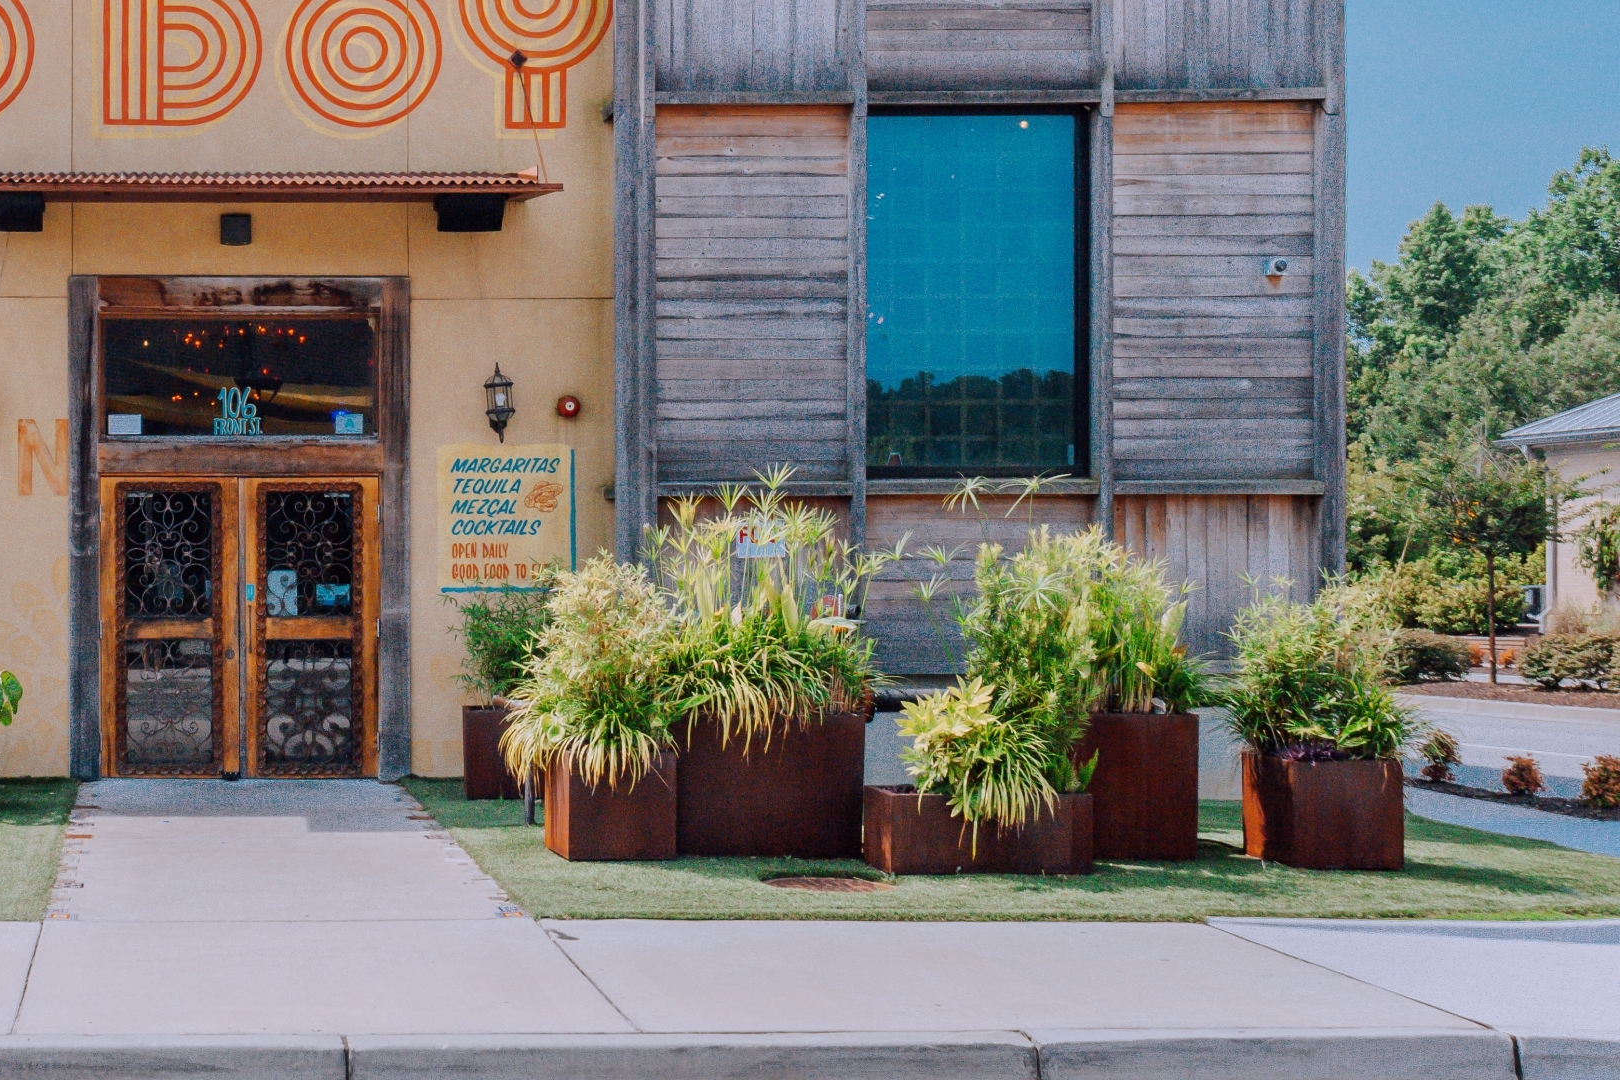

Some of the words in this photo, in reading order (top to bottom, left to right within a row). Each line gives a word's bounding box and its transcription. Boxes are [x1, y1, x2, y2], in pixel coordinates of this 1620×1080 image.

[217, 386, 257, 418] 106
[213, 417, 248, 435] FRONT
[248, 417, 263, 436] ST.
[450, 457, 561, 474] MARGARITAS
[452, 478, 522, 494] TEQUILA
[451, 519, 542, 536] COCKTAILS
[451, 542, 477, 559] OPEN
[482, 542, 509, 559] DAILY
[451, 563, 479, 580] GOOD
[484, 563, 510, 580] FOOD
[514, 563, 527, 579] TO
